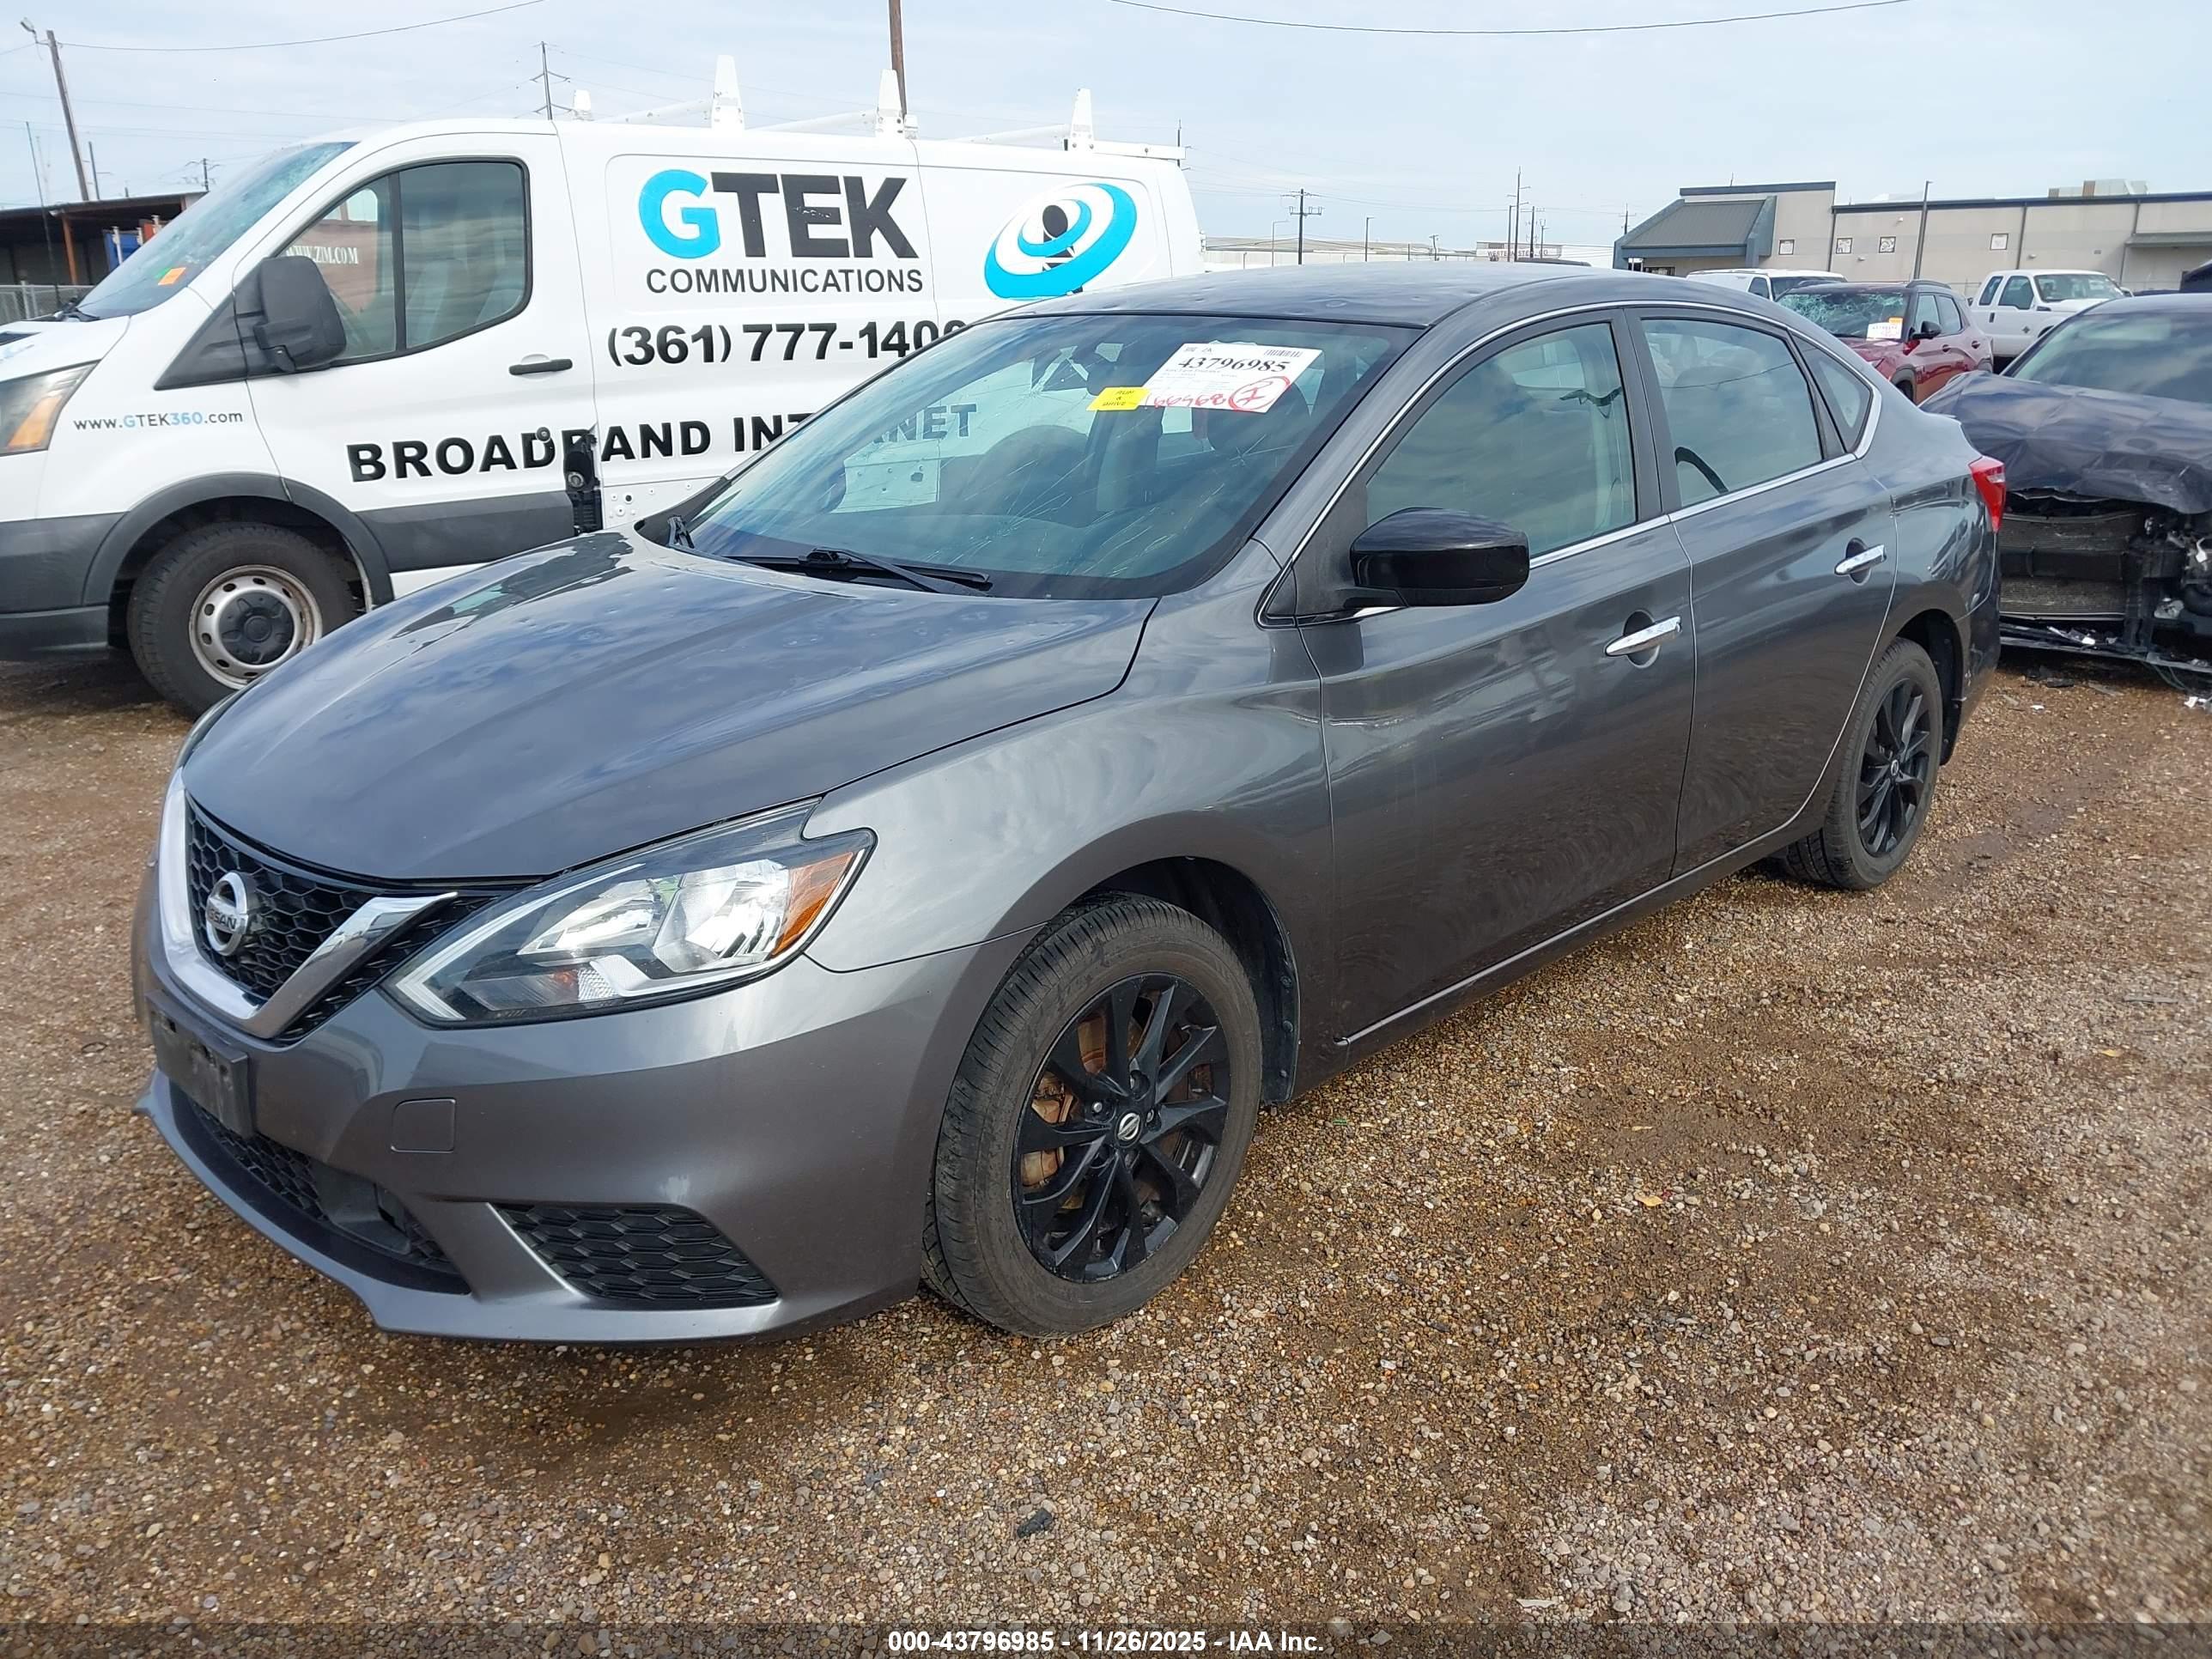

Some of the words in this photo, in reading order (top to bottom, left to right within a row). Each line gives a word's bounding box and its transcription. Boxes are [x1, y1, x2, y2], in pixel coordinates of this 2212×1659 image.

[639, 169, 920, 259] GTEK
[646, 269, 924, 294] COMMUNICATIONS
[607, 325, 732, 367] (361)
[1178, 357, 1291, 372] 43796985
[74, 412, 243, 430] www.GTEK360.com
